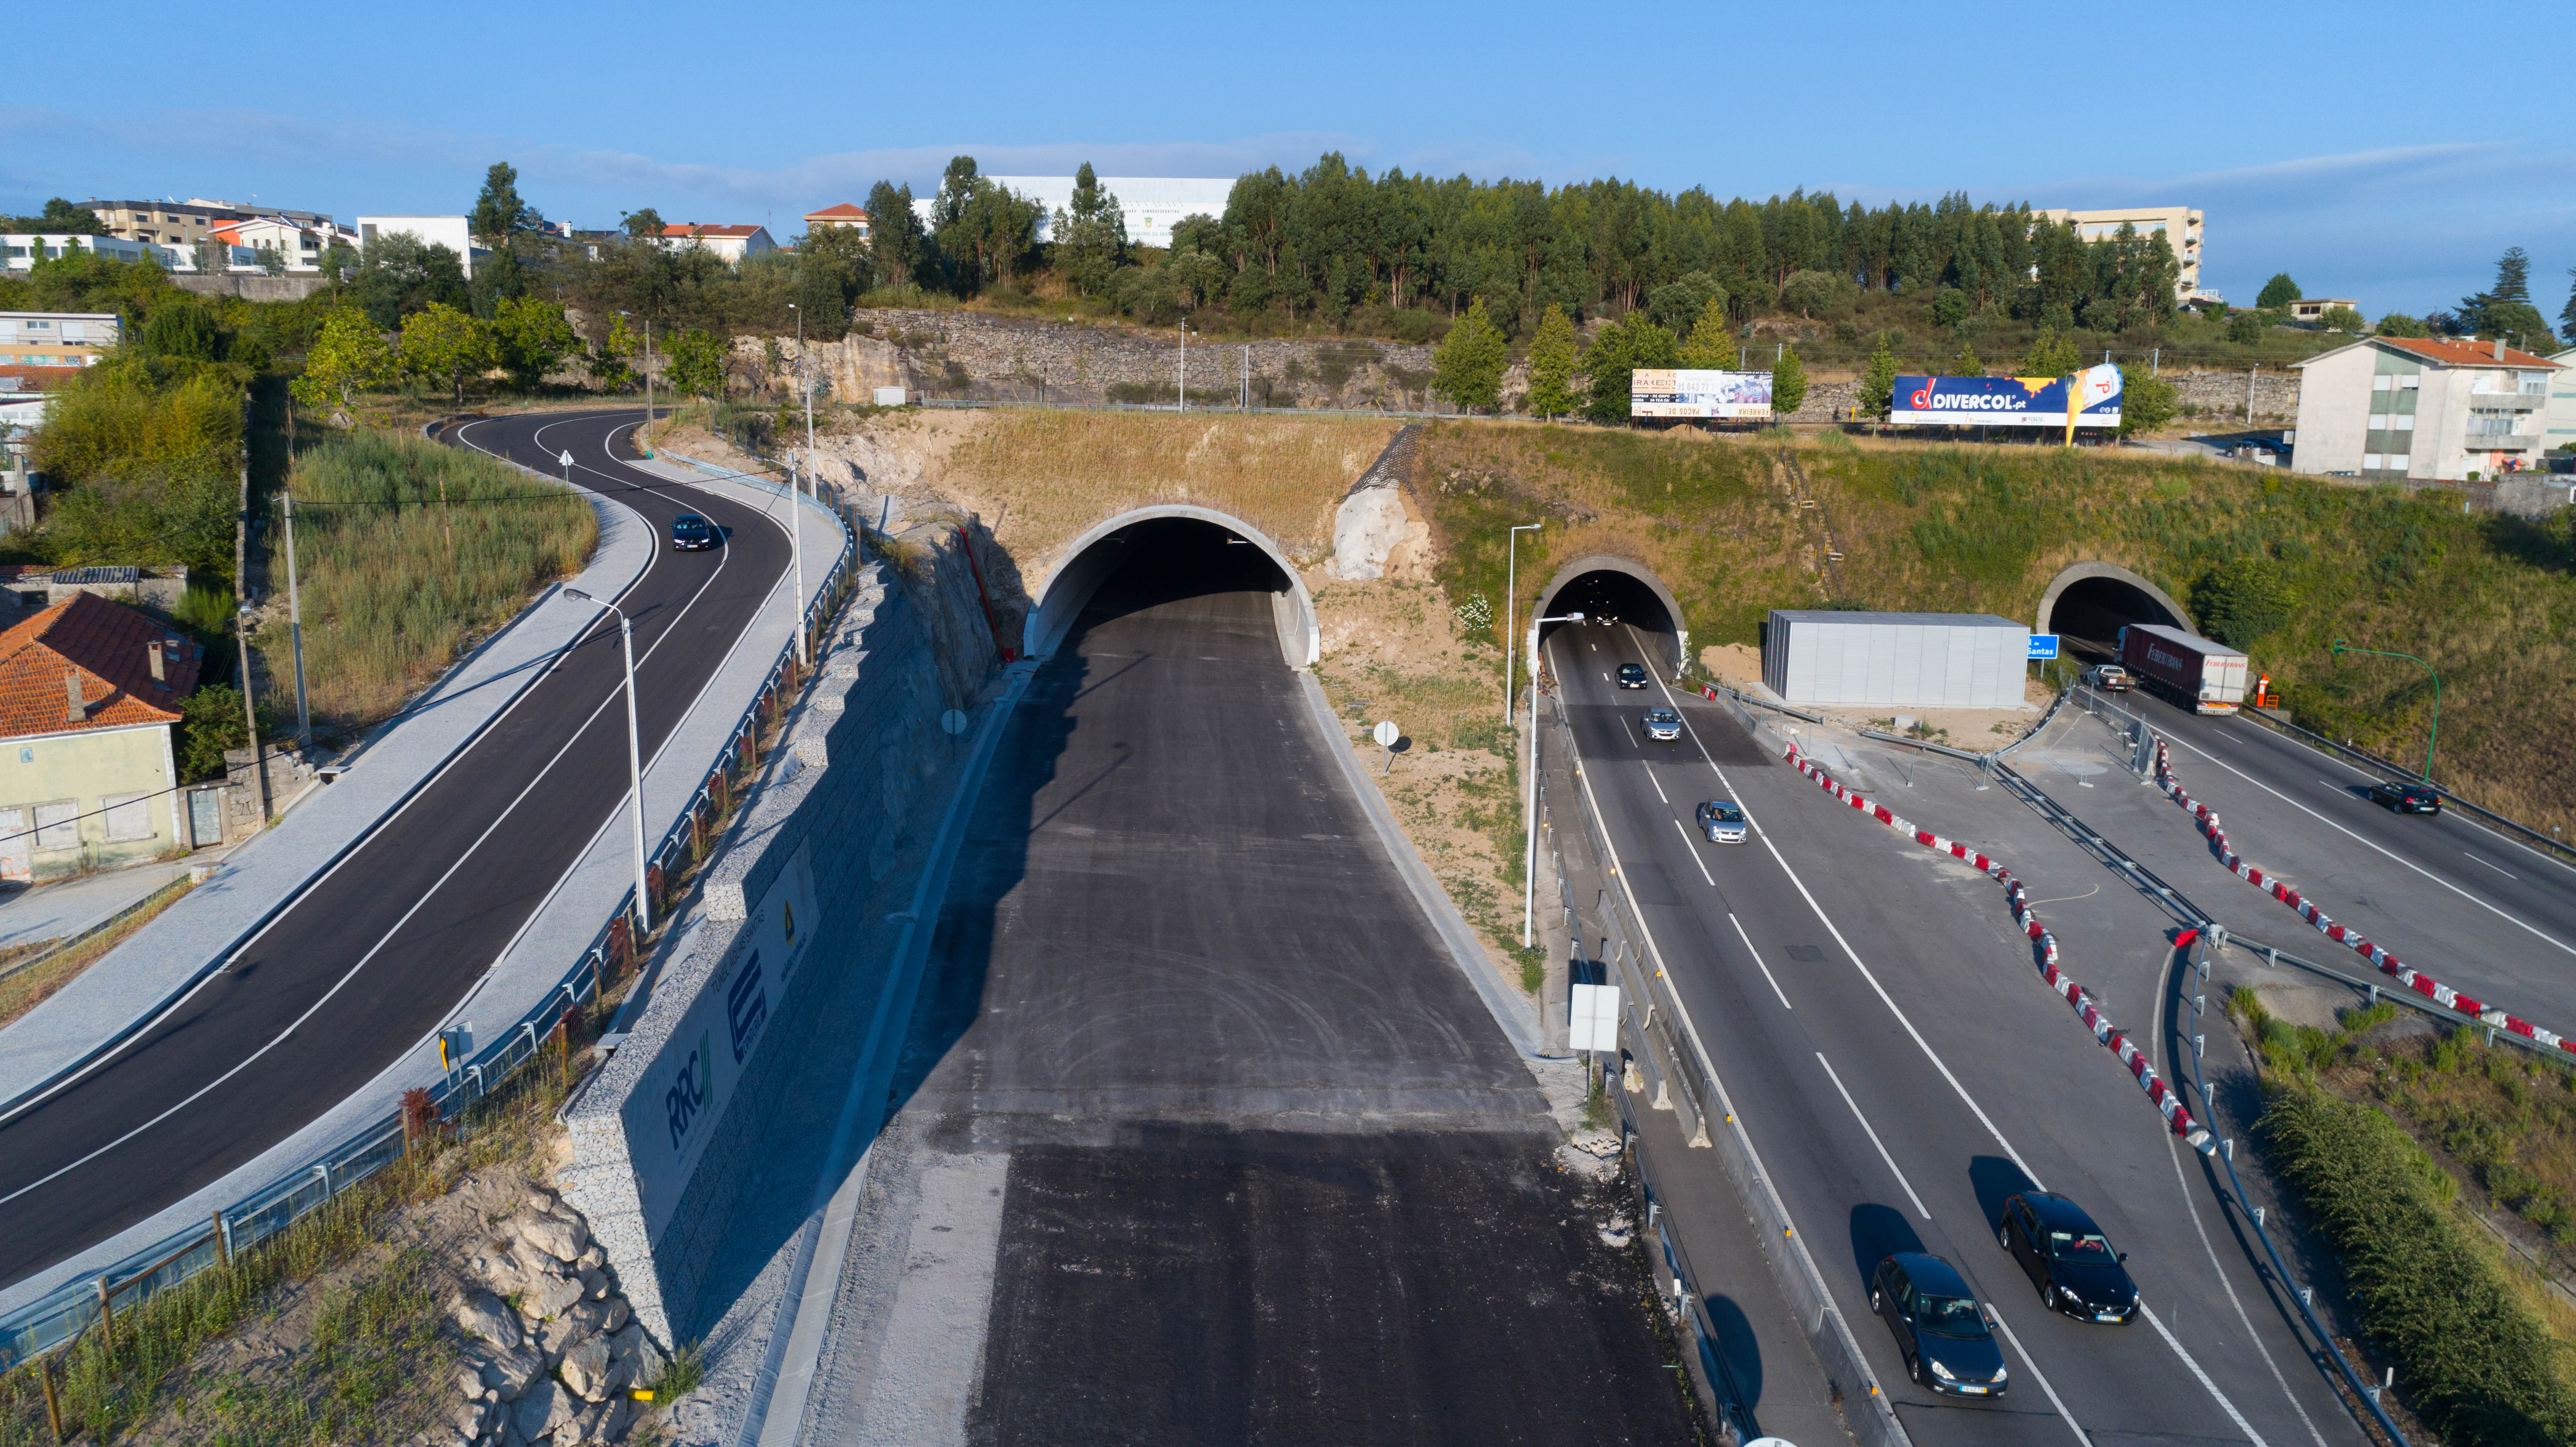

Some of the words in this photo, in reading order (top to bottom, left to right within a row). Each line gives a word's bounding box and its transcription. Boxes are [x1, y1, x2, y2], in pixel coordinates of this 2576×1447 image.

[2147, 642, 2183, 671] FEBERTRANS
[2205, 659, 2245, 668] FEBERTRANS
[665, 1050, 703, 1151] RRC
